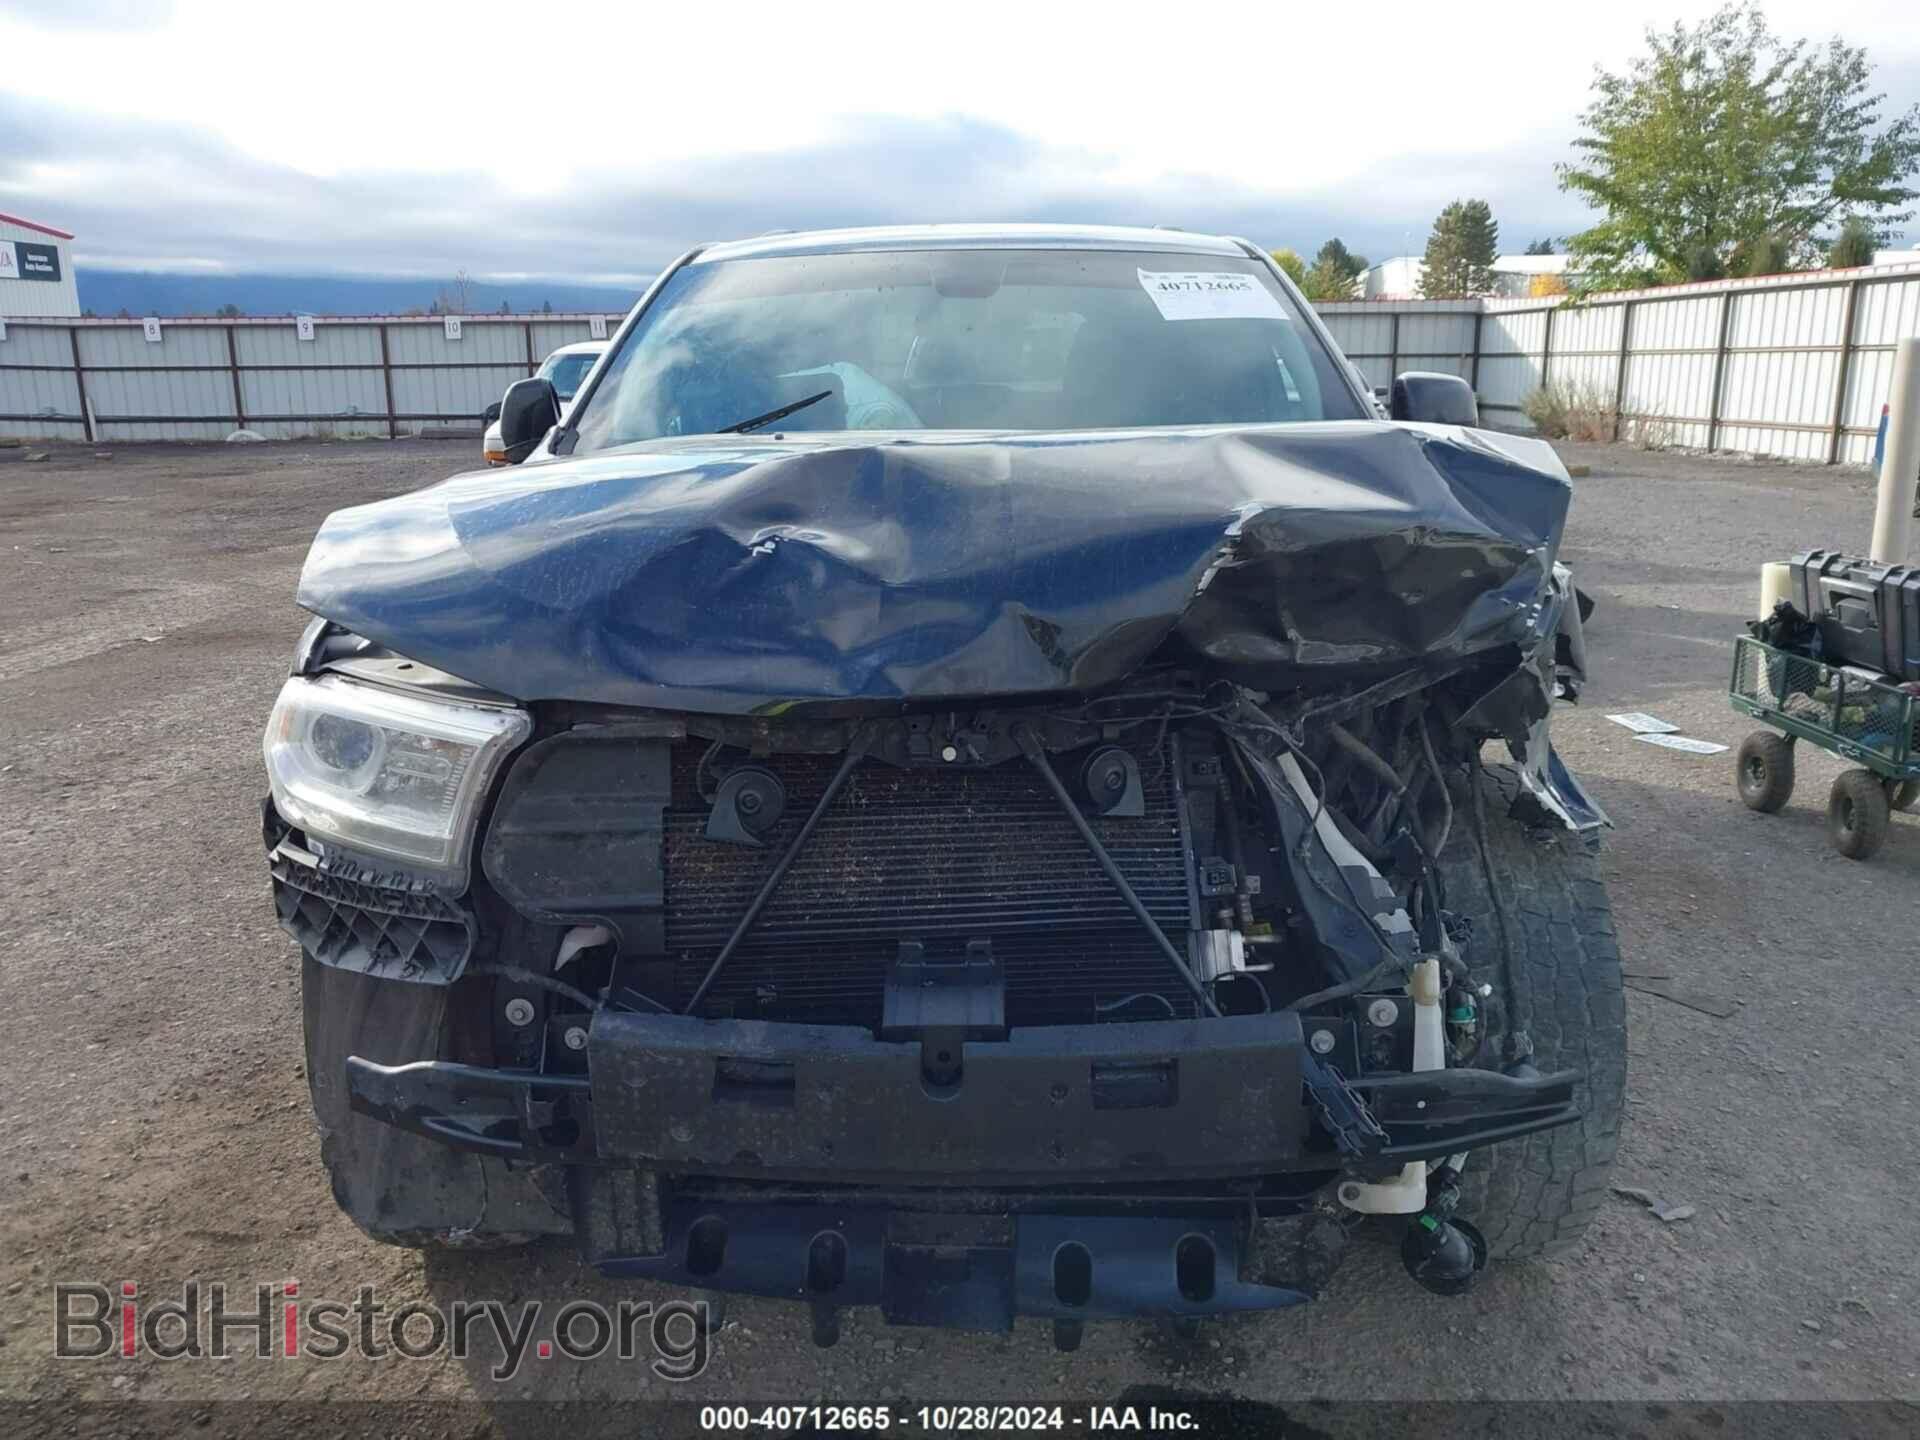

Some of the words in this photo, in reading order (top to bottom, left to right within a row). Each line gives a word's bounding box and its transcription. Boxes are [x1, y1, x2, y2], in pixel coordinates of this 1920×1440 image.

[1158, 281, 1252, 292] 40712665
[149, 324, 155, 335] 8
[303, 322, 309, 333] 9
[448, 322, 458, 332] 10
